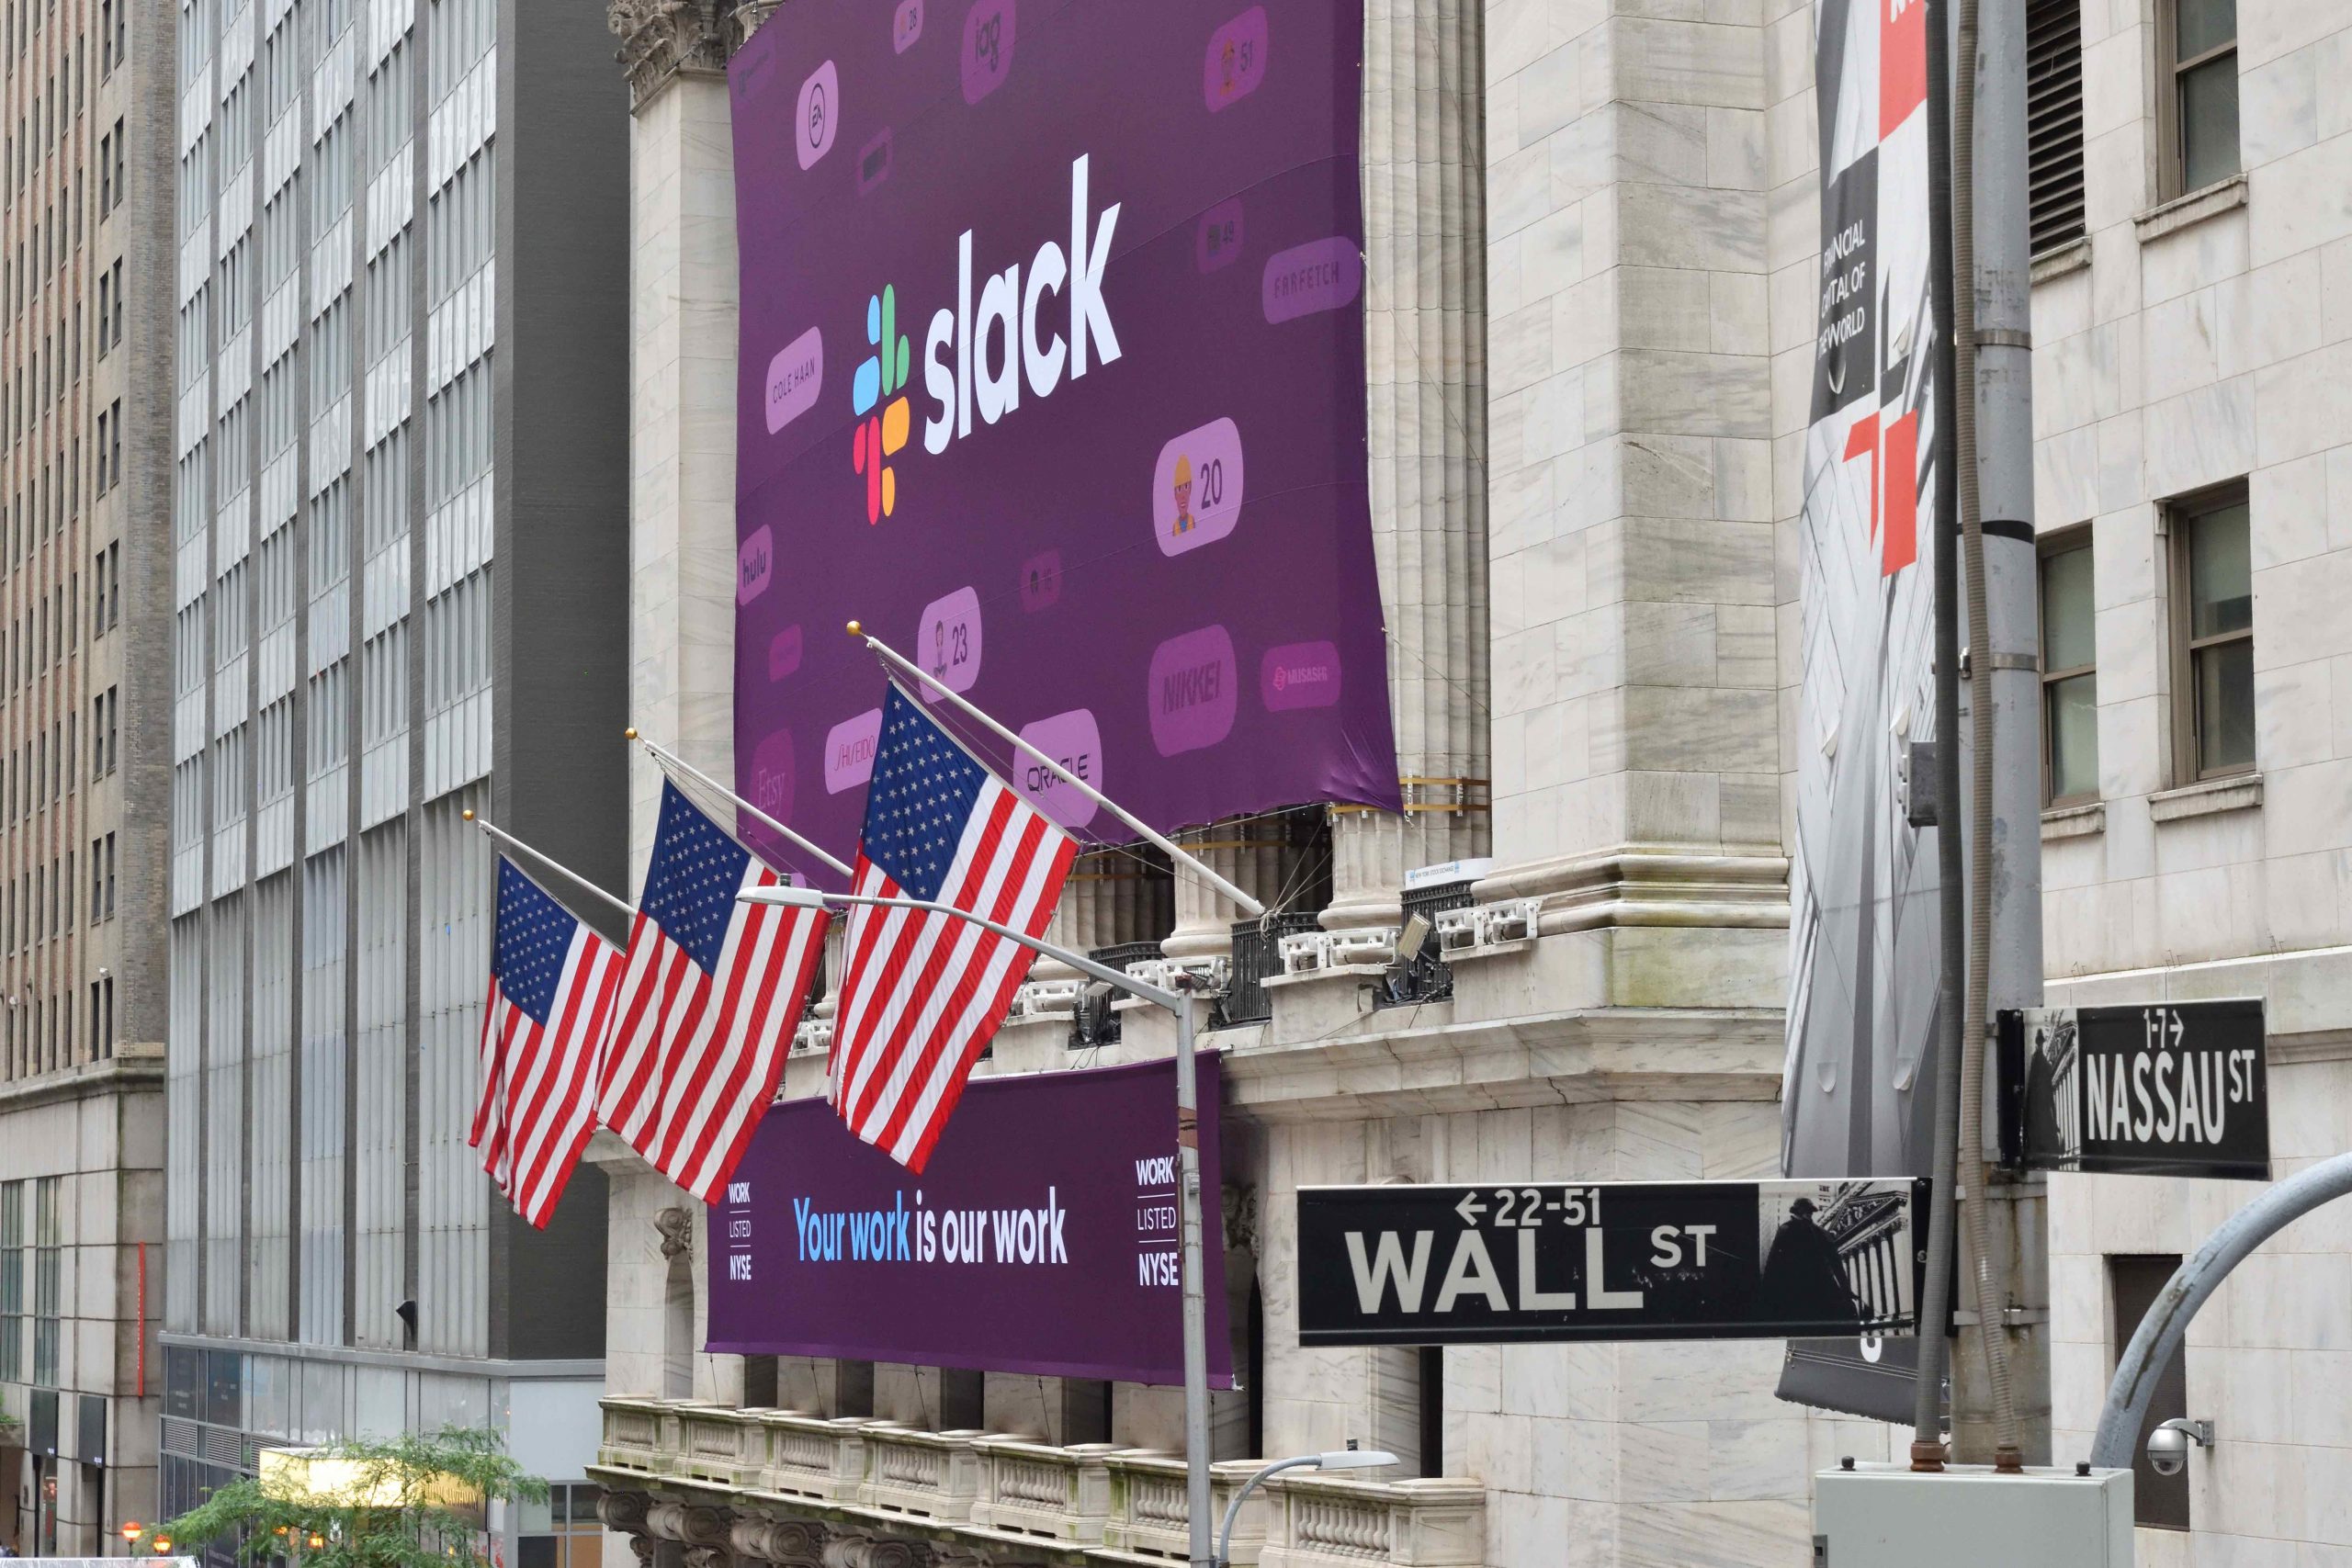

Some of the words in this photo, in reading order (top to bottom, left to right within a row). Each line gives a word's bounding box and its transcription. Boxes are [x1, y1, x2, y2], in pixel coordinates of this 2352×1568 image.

[975, 11, 1001, 73] iag
[1273, 260, 1340, 299] FARFETCH
[1850, 261, 1866, 294] OF
[923, 152, 1123, 455] slack
[1826, 305, 1866, 350] WORLD
[772, 372, 792, 405] COLE
[794, 355, 815, 389] HAAN
[1200, 457, 1223, 511] 20
[742, 547, 766, 589] hulu
[952, 622, 967, 667] 23
[1161, 660, 1221, 716] NIKKEI
[833, 735, 876, 772] SHISEIDO
[758, 767, 786, 817] Etsy
[2143, 1008, 2166, 1049] 1-7
[2086, 1051, 2225, 1145] NASSAU
[2228, 1049, 2256, 1103] ST
[1136, 1156, 1175, 1186] WORK
[728, 1181, 751, 1204] WORK
[1493, 1188, 1601, 1227] 22-51
[729, 1220, 752, 1238] LISTED
[793, 1197, 845, 1262] Your
[849, 1190, 911, 1262] work
[916, 1189, 936, 1263] is
[941, 1210, 988, 1264] our
[992, 1185, 1069, 1265] work
[1136, 1206, 1177, 1231] LISTED
[729, 1254, 752, 1280] NYSE
[1138, 1252, 1179, 1287] NYSE
[1343, 1227, 1645, 1314] WALL
[1649, 1224, 1717, 1269] ST
